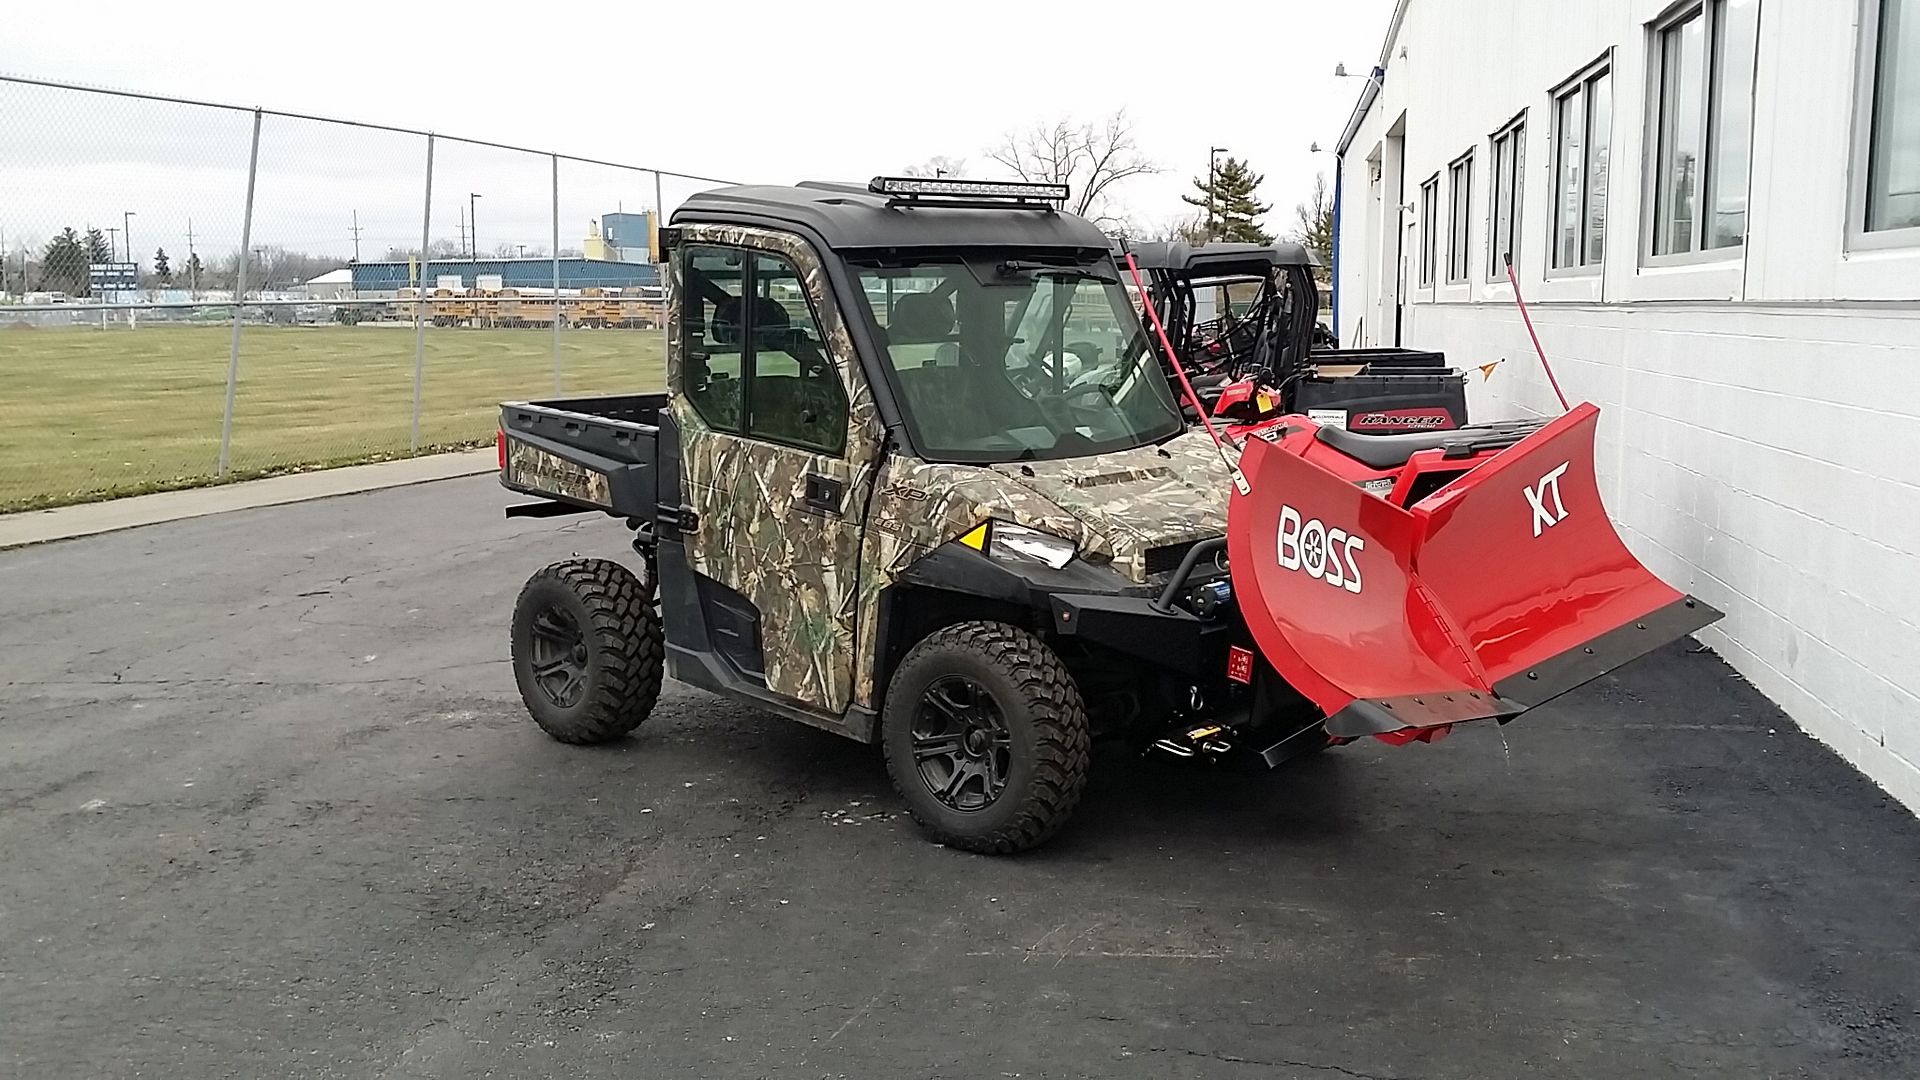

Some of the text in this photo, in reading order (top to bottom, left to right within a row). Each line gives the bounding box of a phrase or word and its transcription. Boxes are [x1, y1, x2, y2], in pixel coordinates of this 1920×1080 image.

[1359, 415, 1446, 425] RANGER
[515, 460, 592, 486] RANGER
[879, 483, 928, 502] XP
[1522, 460, 1570, 538] XT
[1277, 504, 1365, 594] BOSS
